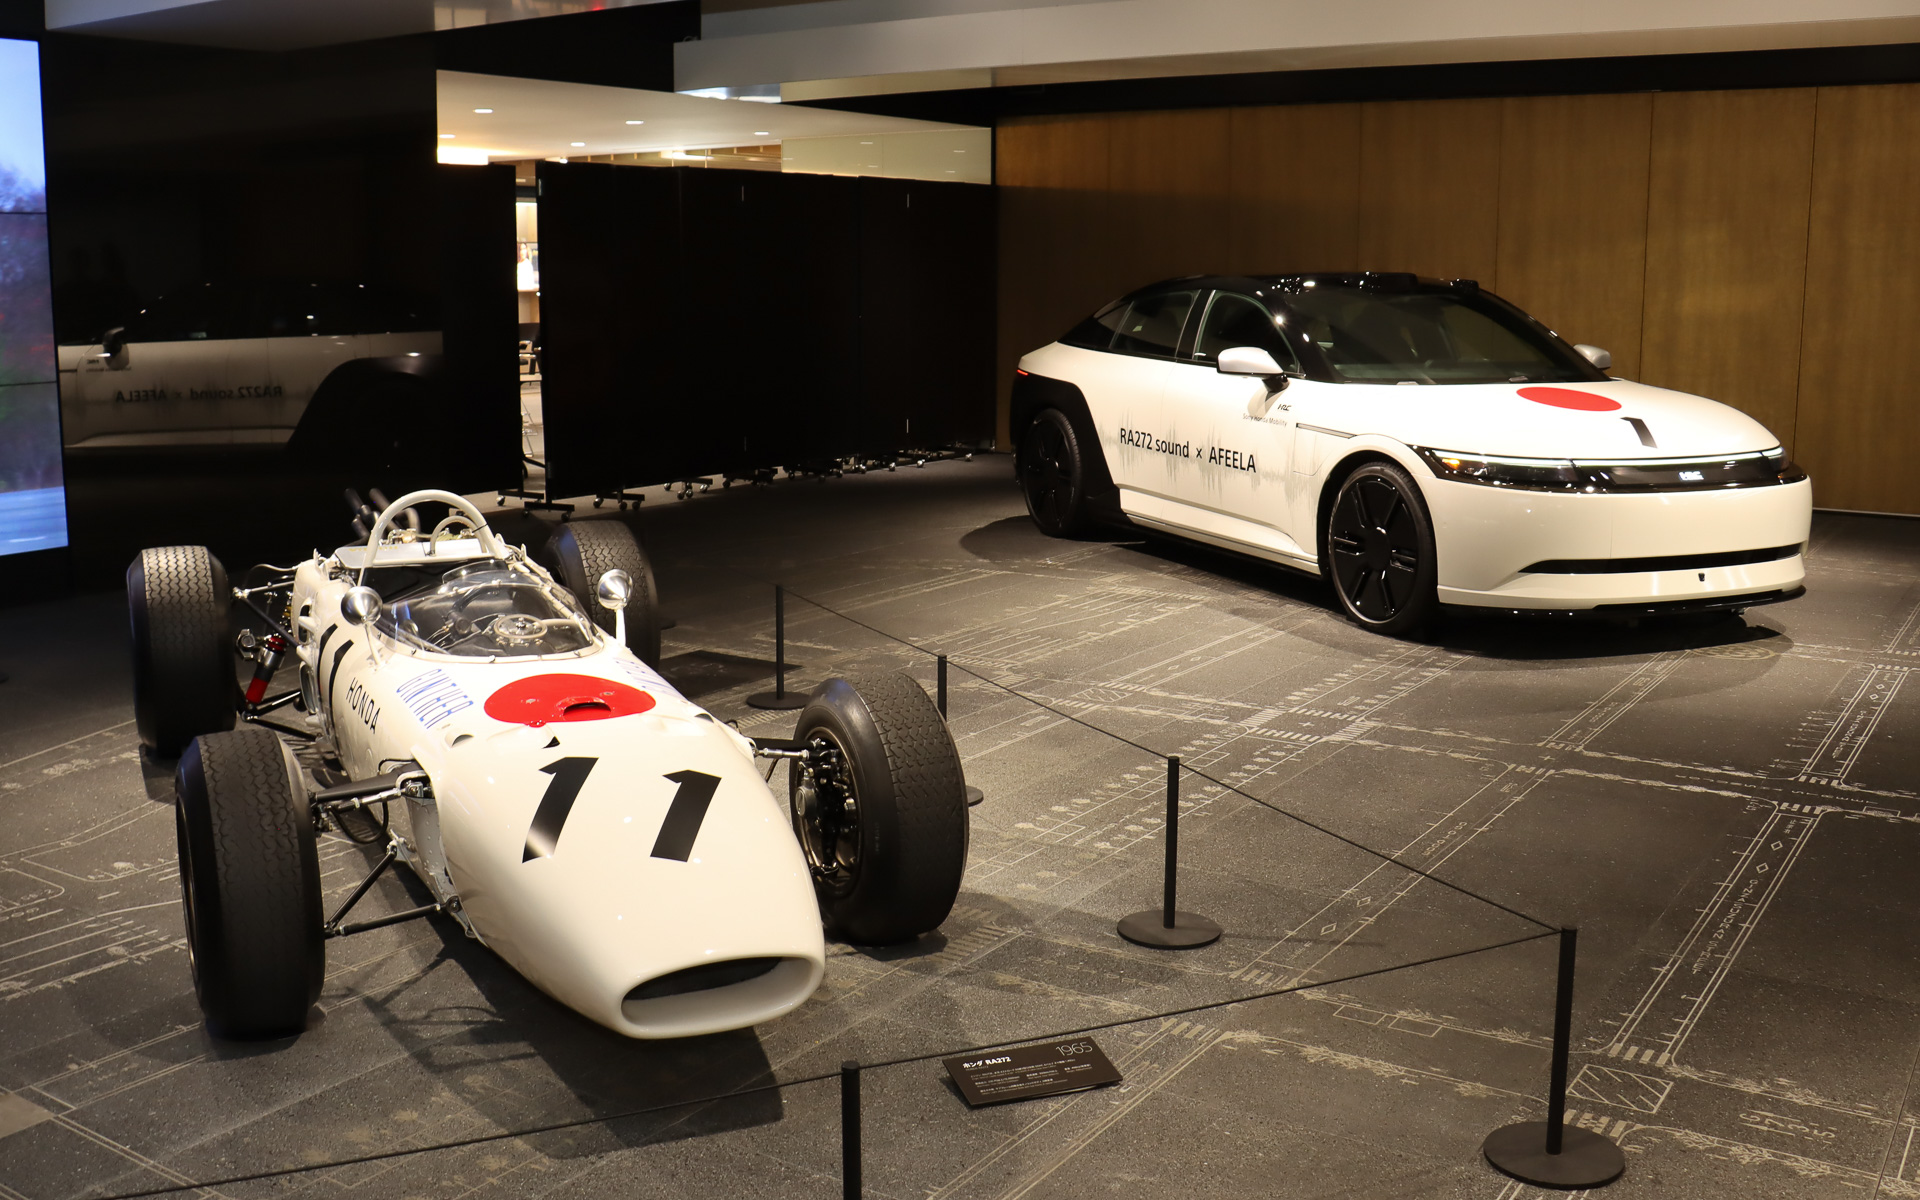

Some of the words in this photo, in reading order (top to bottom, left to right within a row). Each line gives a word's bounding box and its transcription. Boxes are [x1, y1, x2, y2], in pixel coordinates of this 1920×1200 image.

[1120, 428, 1152, 450] RA272
[1155, 438, 1190, 458] sound
[1209, 446, 1256, 473] AFEELA
[345, 677, 381, 735] HONDA
[984, 1056, 1012, 1065] RA272
[1055, 1041, 1093, 1057] 1965
